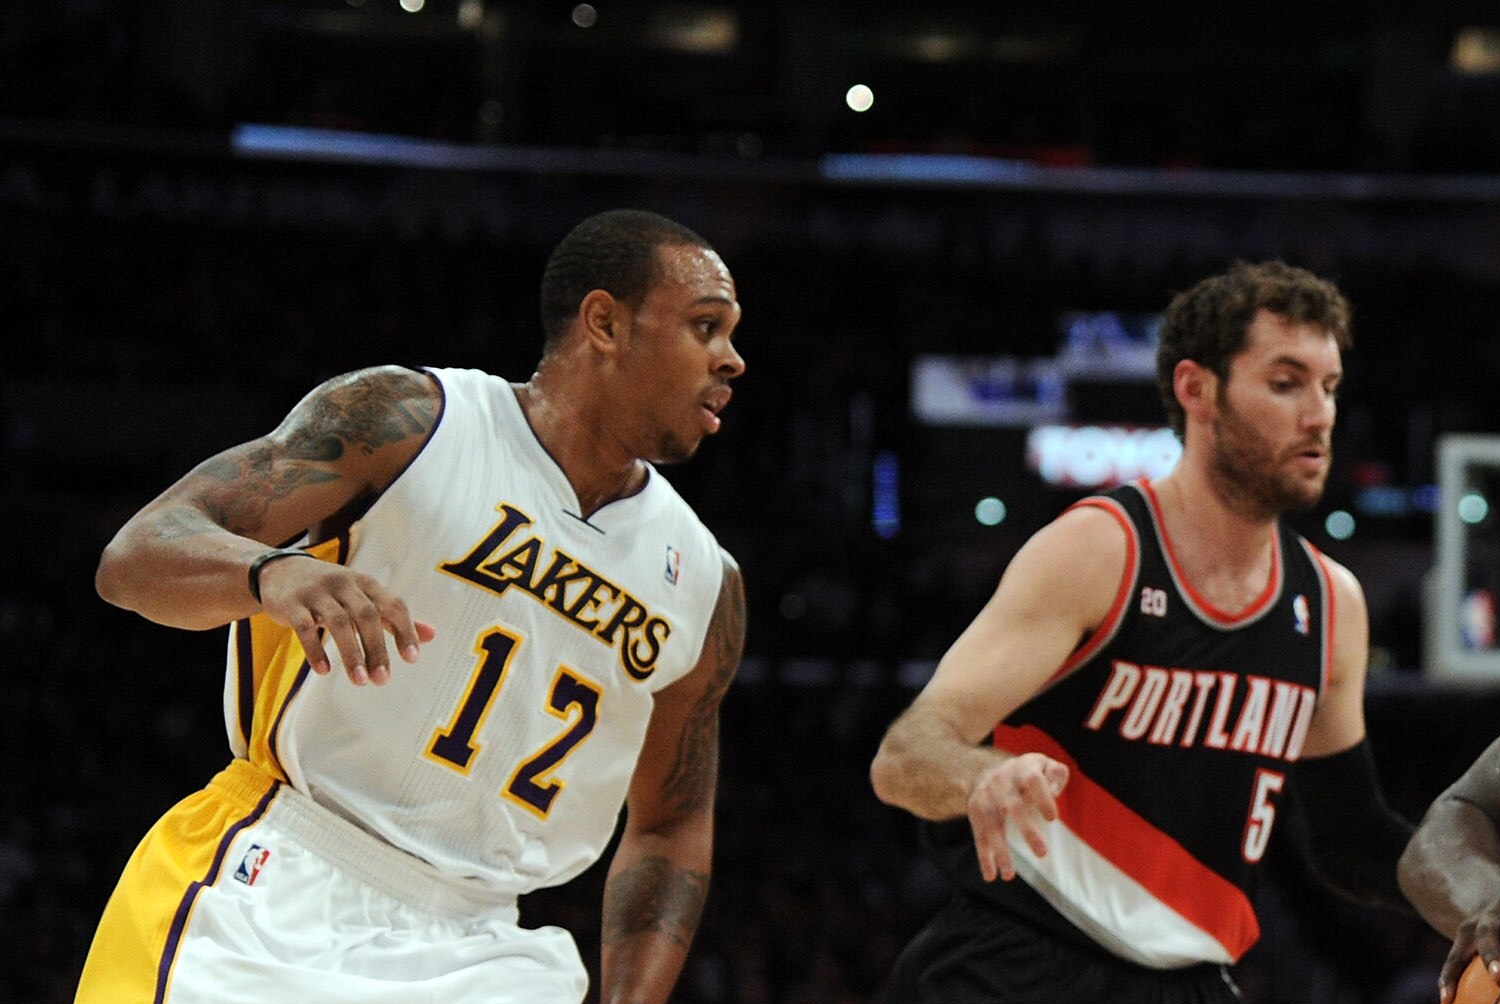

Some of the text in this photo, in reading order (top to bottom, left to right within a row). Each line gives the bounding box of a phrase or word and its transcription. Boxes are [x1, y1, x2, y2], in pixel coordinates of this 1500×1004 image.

[434, 500, 672, 683] LAKERS
[422, 620, 605, 822] 12
[1242, 766, 1286, 867] 5
